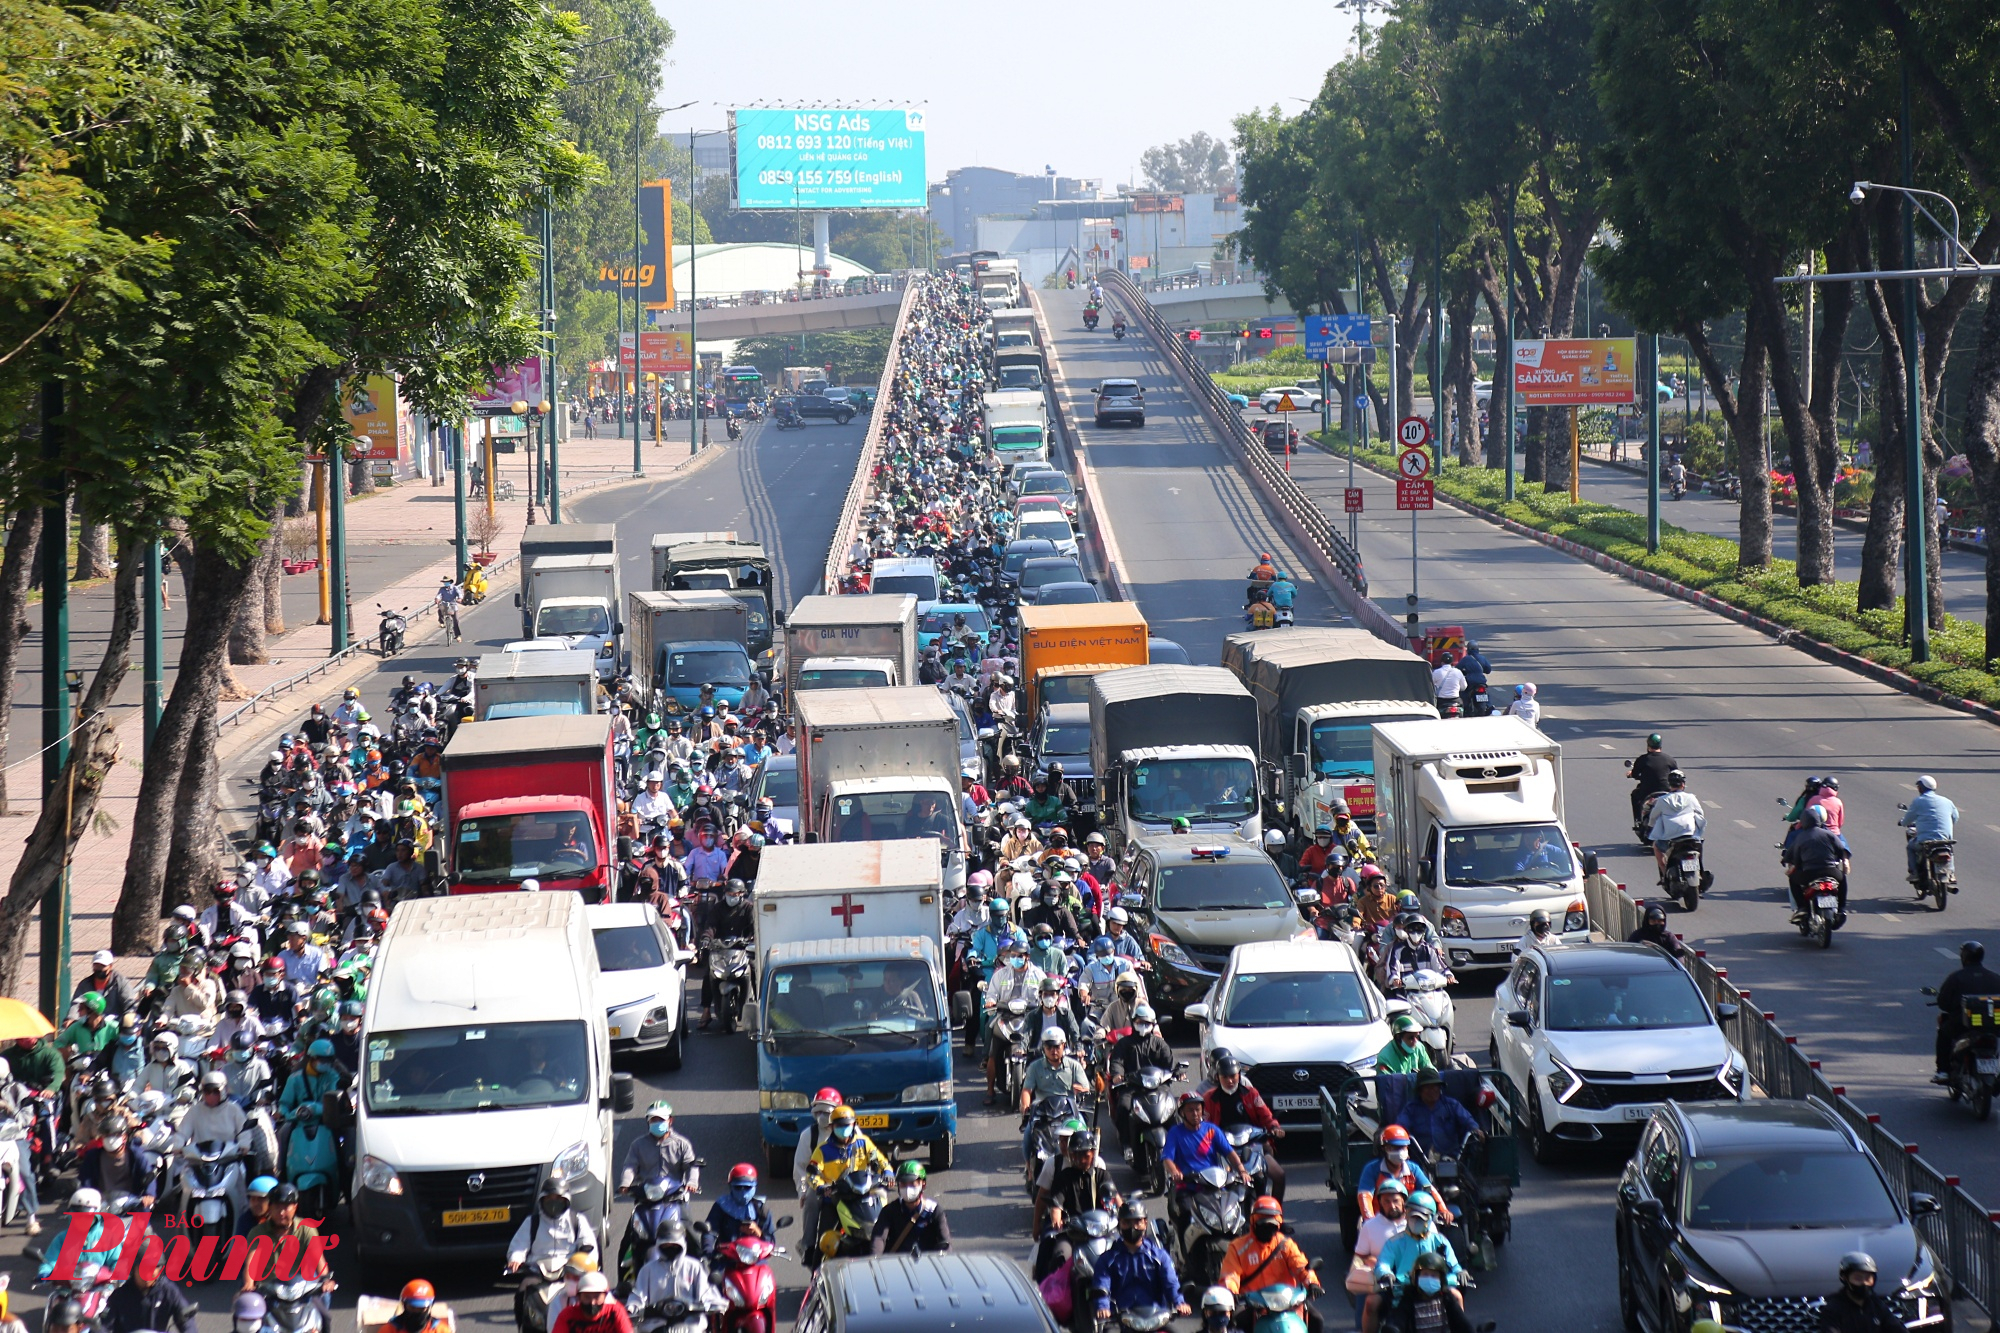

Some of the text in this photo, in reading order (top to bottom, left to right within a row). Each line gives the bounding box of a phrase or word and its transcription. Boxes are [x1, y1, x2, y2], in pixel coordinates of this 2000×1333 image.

[794, 114, 870, 131] NSG Ads
[757, 135, 792, 149] 0812
[796, 135, 822, 149] 693
[826, 135, 851, 149] 120
[888, 136, 913, 151] Việt)
[854, 152, 868, 161] CÁO
[758, 170, 902, 185] 0859 155 759 (English)
[1517, 370, 1575, 383] SẢN XUẤT
[1405, 480, 1425, 489] CẤM
[1348, 489, 1359, 498] CẤM
[821, 628, 860, 639] GIA HUY
[1033, 637, 1139, 649] BƯU ĐIỆN VIỆT NAM
